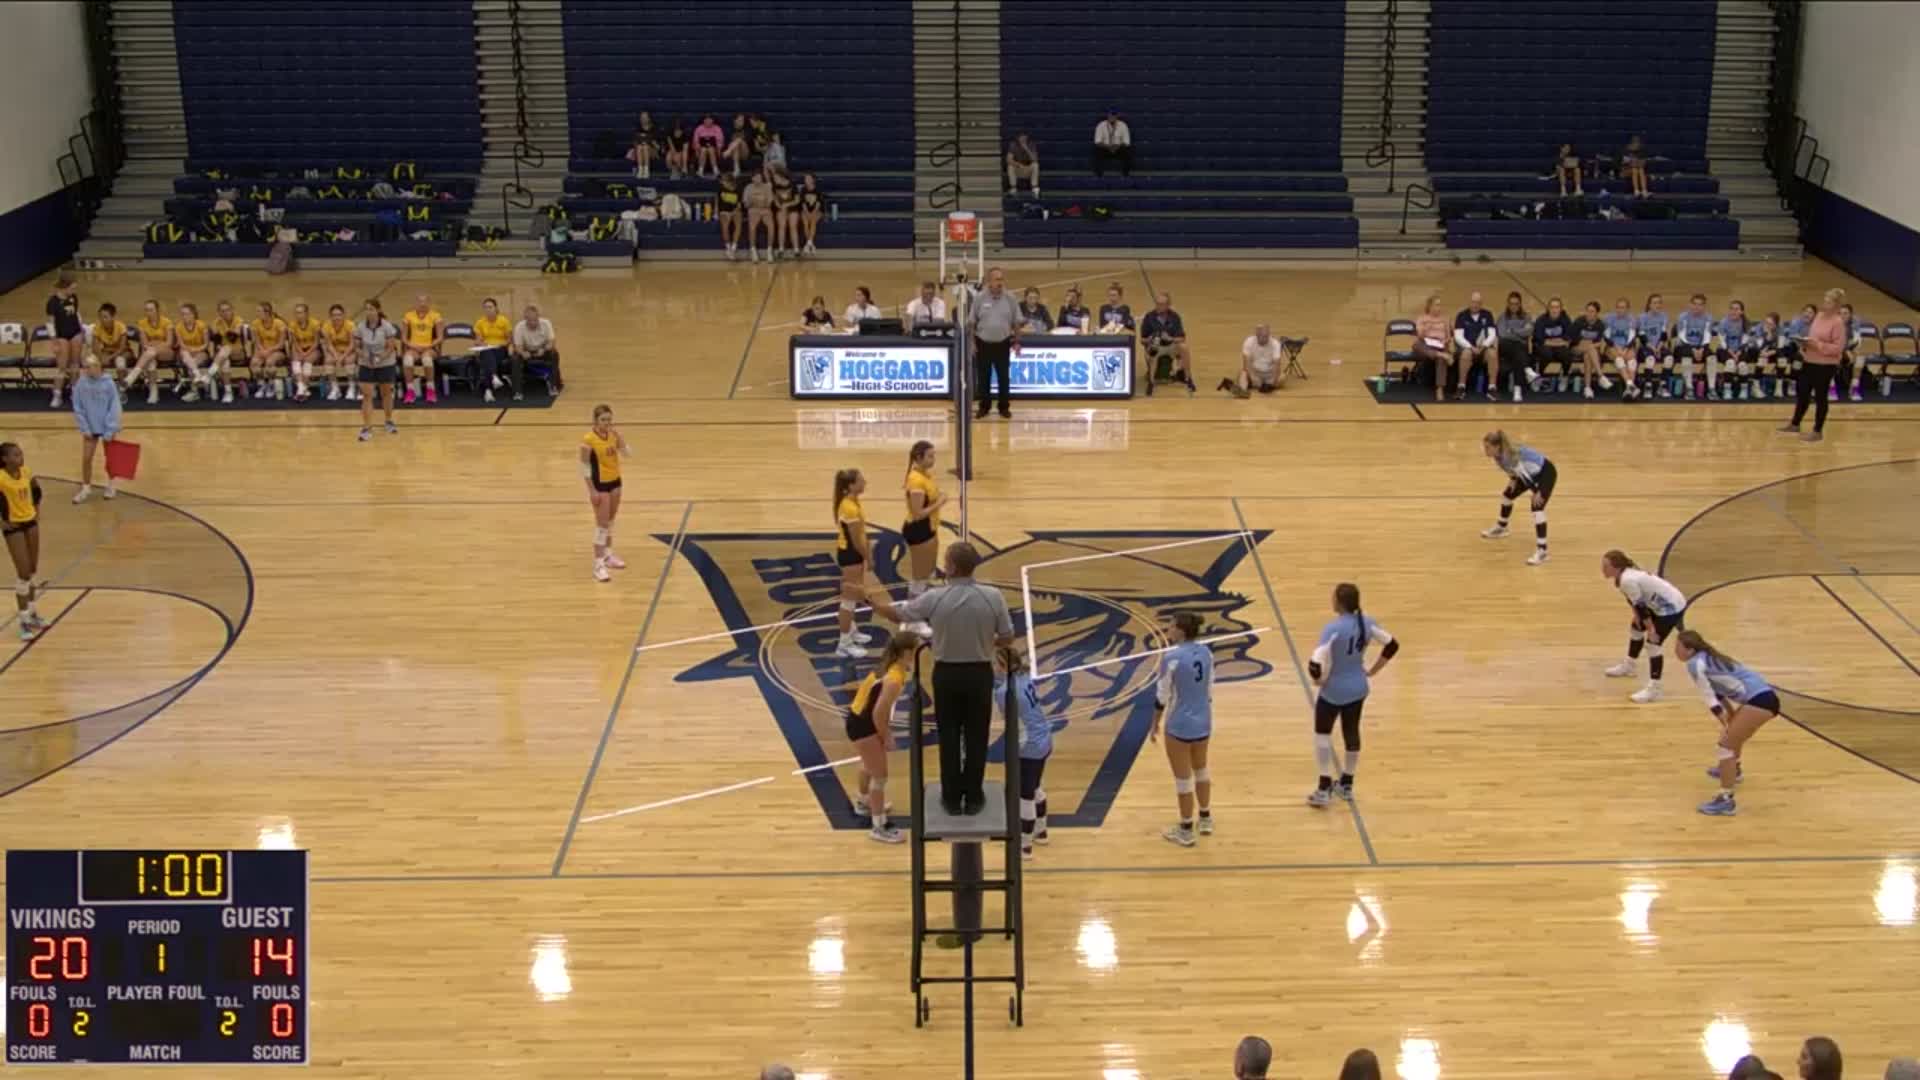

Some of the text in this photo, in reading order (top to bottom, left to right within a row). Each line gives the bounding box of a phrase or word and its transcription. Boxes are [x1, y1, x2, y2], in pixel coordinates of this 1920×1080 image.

[839, 360, 945, 380] HOGGARD
[990, 361, 1089, 384] KINGS
[1193, 661, 1203, 683] 3
